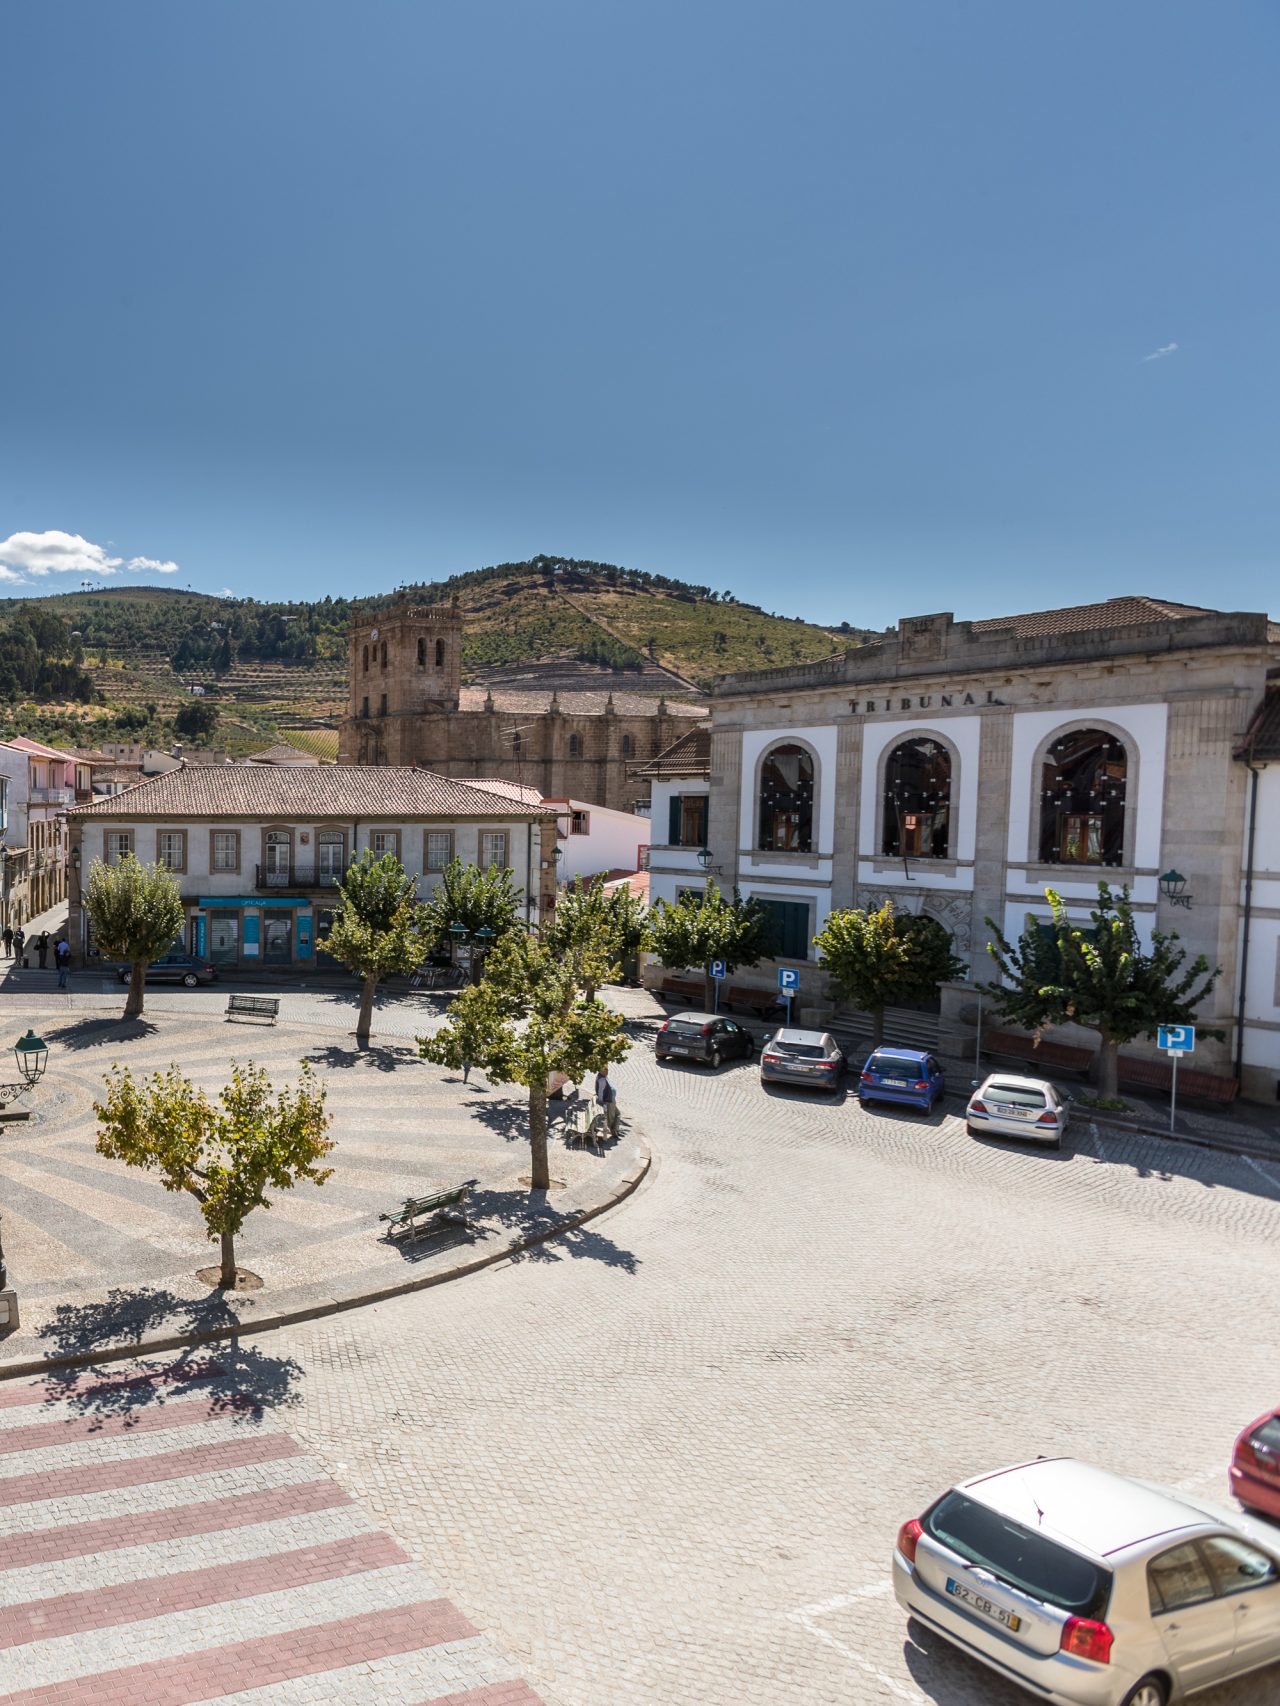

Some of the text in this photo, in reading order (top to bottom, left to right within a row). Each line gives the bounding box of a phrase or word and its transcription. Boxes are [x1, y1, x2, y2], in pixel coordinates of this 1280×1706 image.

[848, 691, 998, 714] TRIBUNAL
[712, 960, 723, 975] P
[782, 971, 796, 986] P
[1167, 1027, 1185, 1047] P
